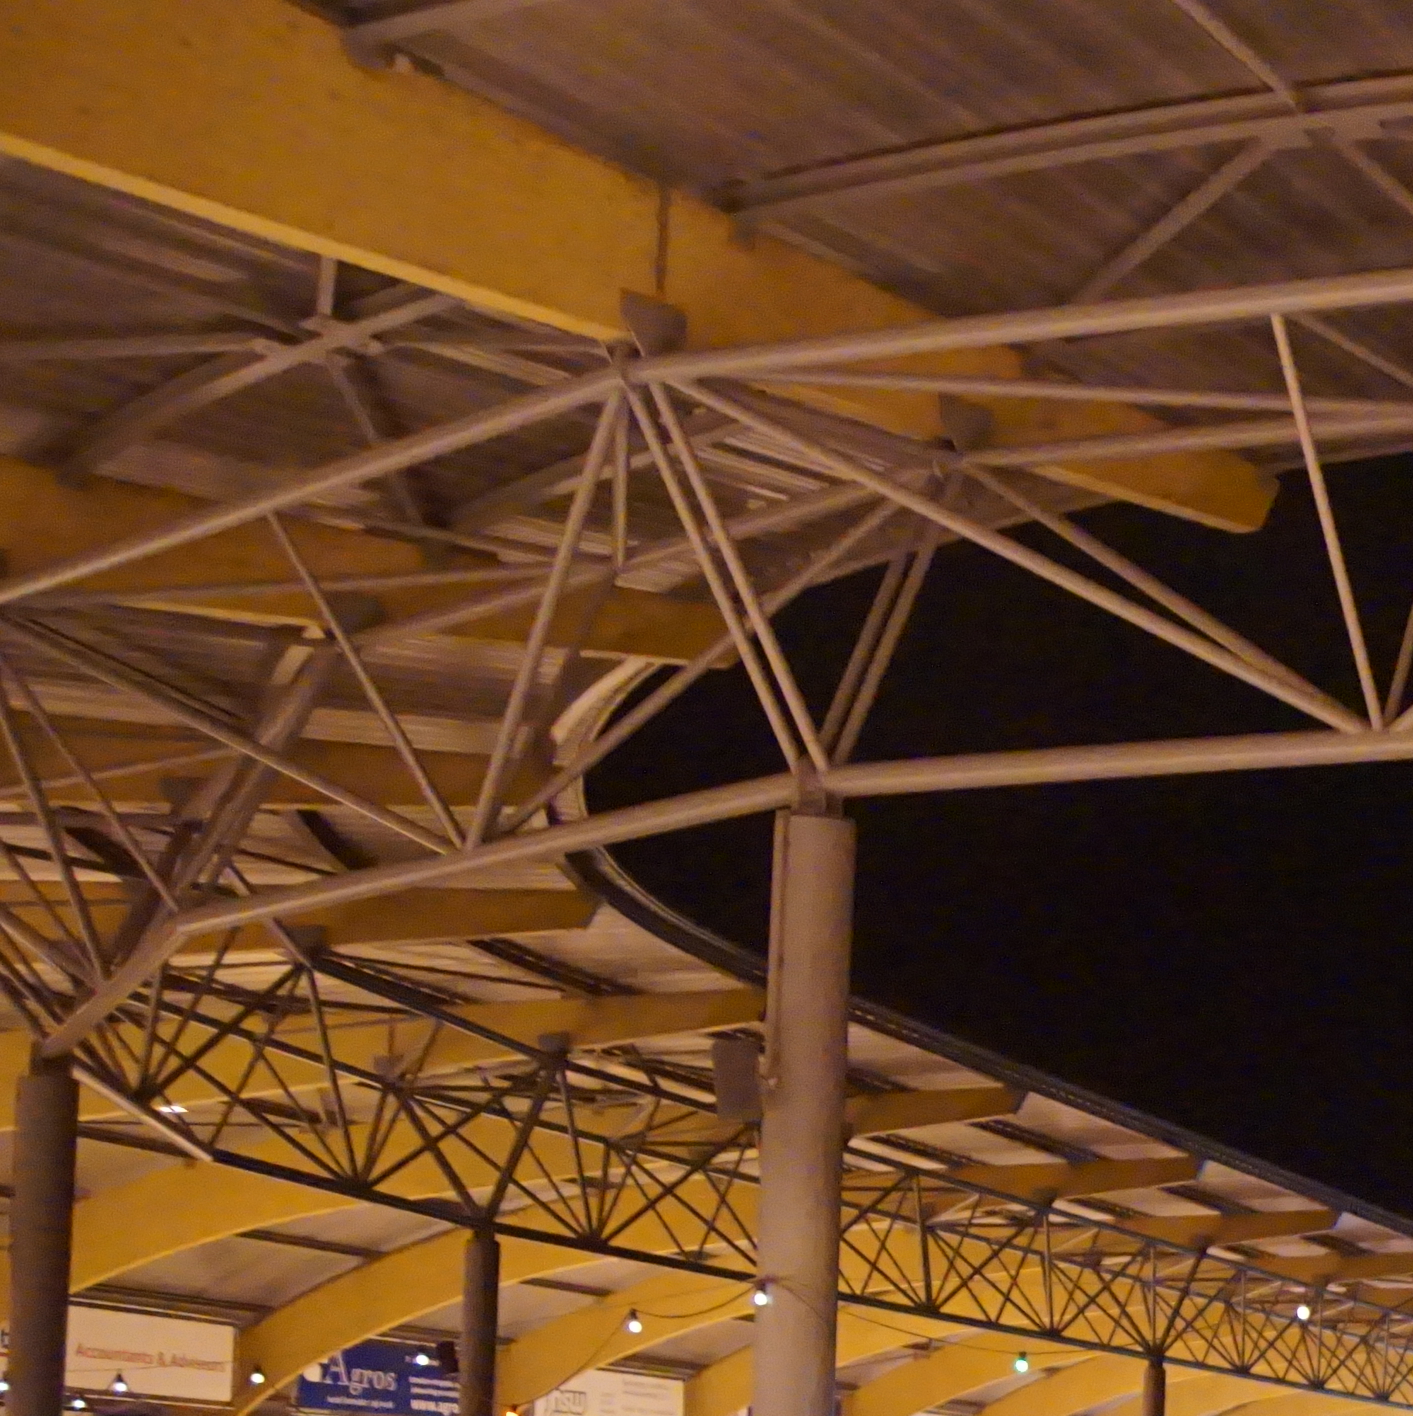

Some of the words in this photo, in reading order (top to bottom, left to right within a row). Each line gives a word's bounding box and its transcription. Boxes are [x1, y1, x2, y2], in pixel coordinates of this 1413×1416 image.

[76, 1342, 155, 1365] Accountants
[157, 1351, 166, 1367] &
[322, 1350, 399, 1395] Agros
